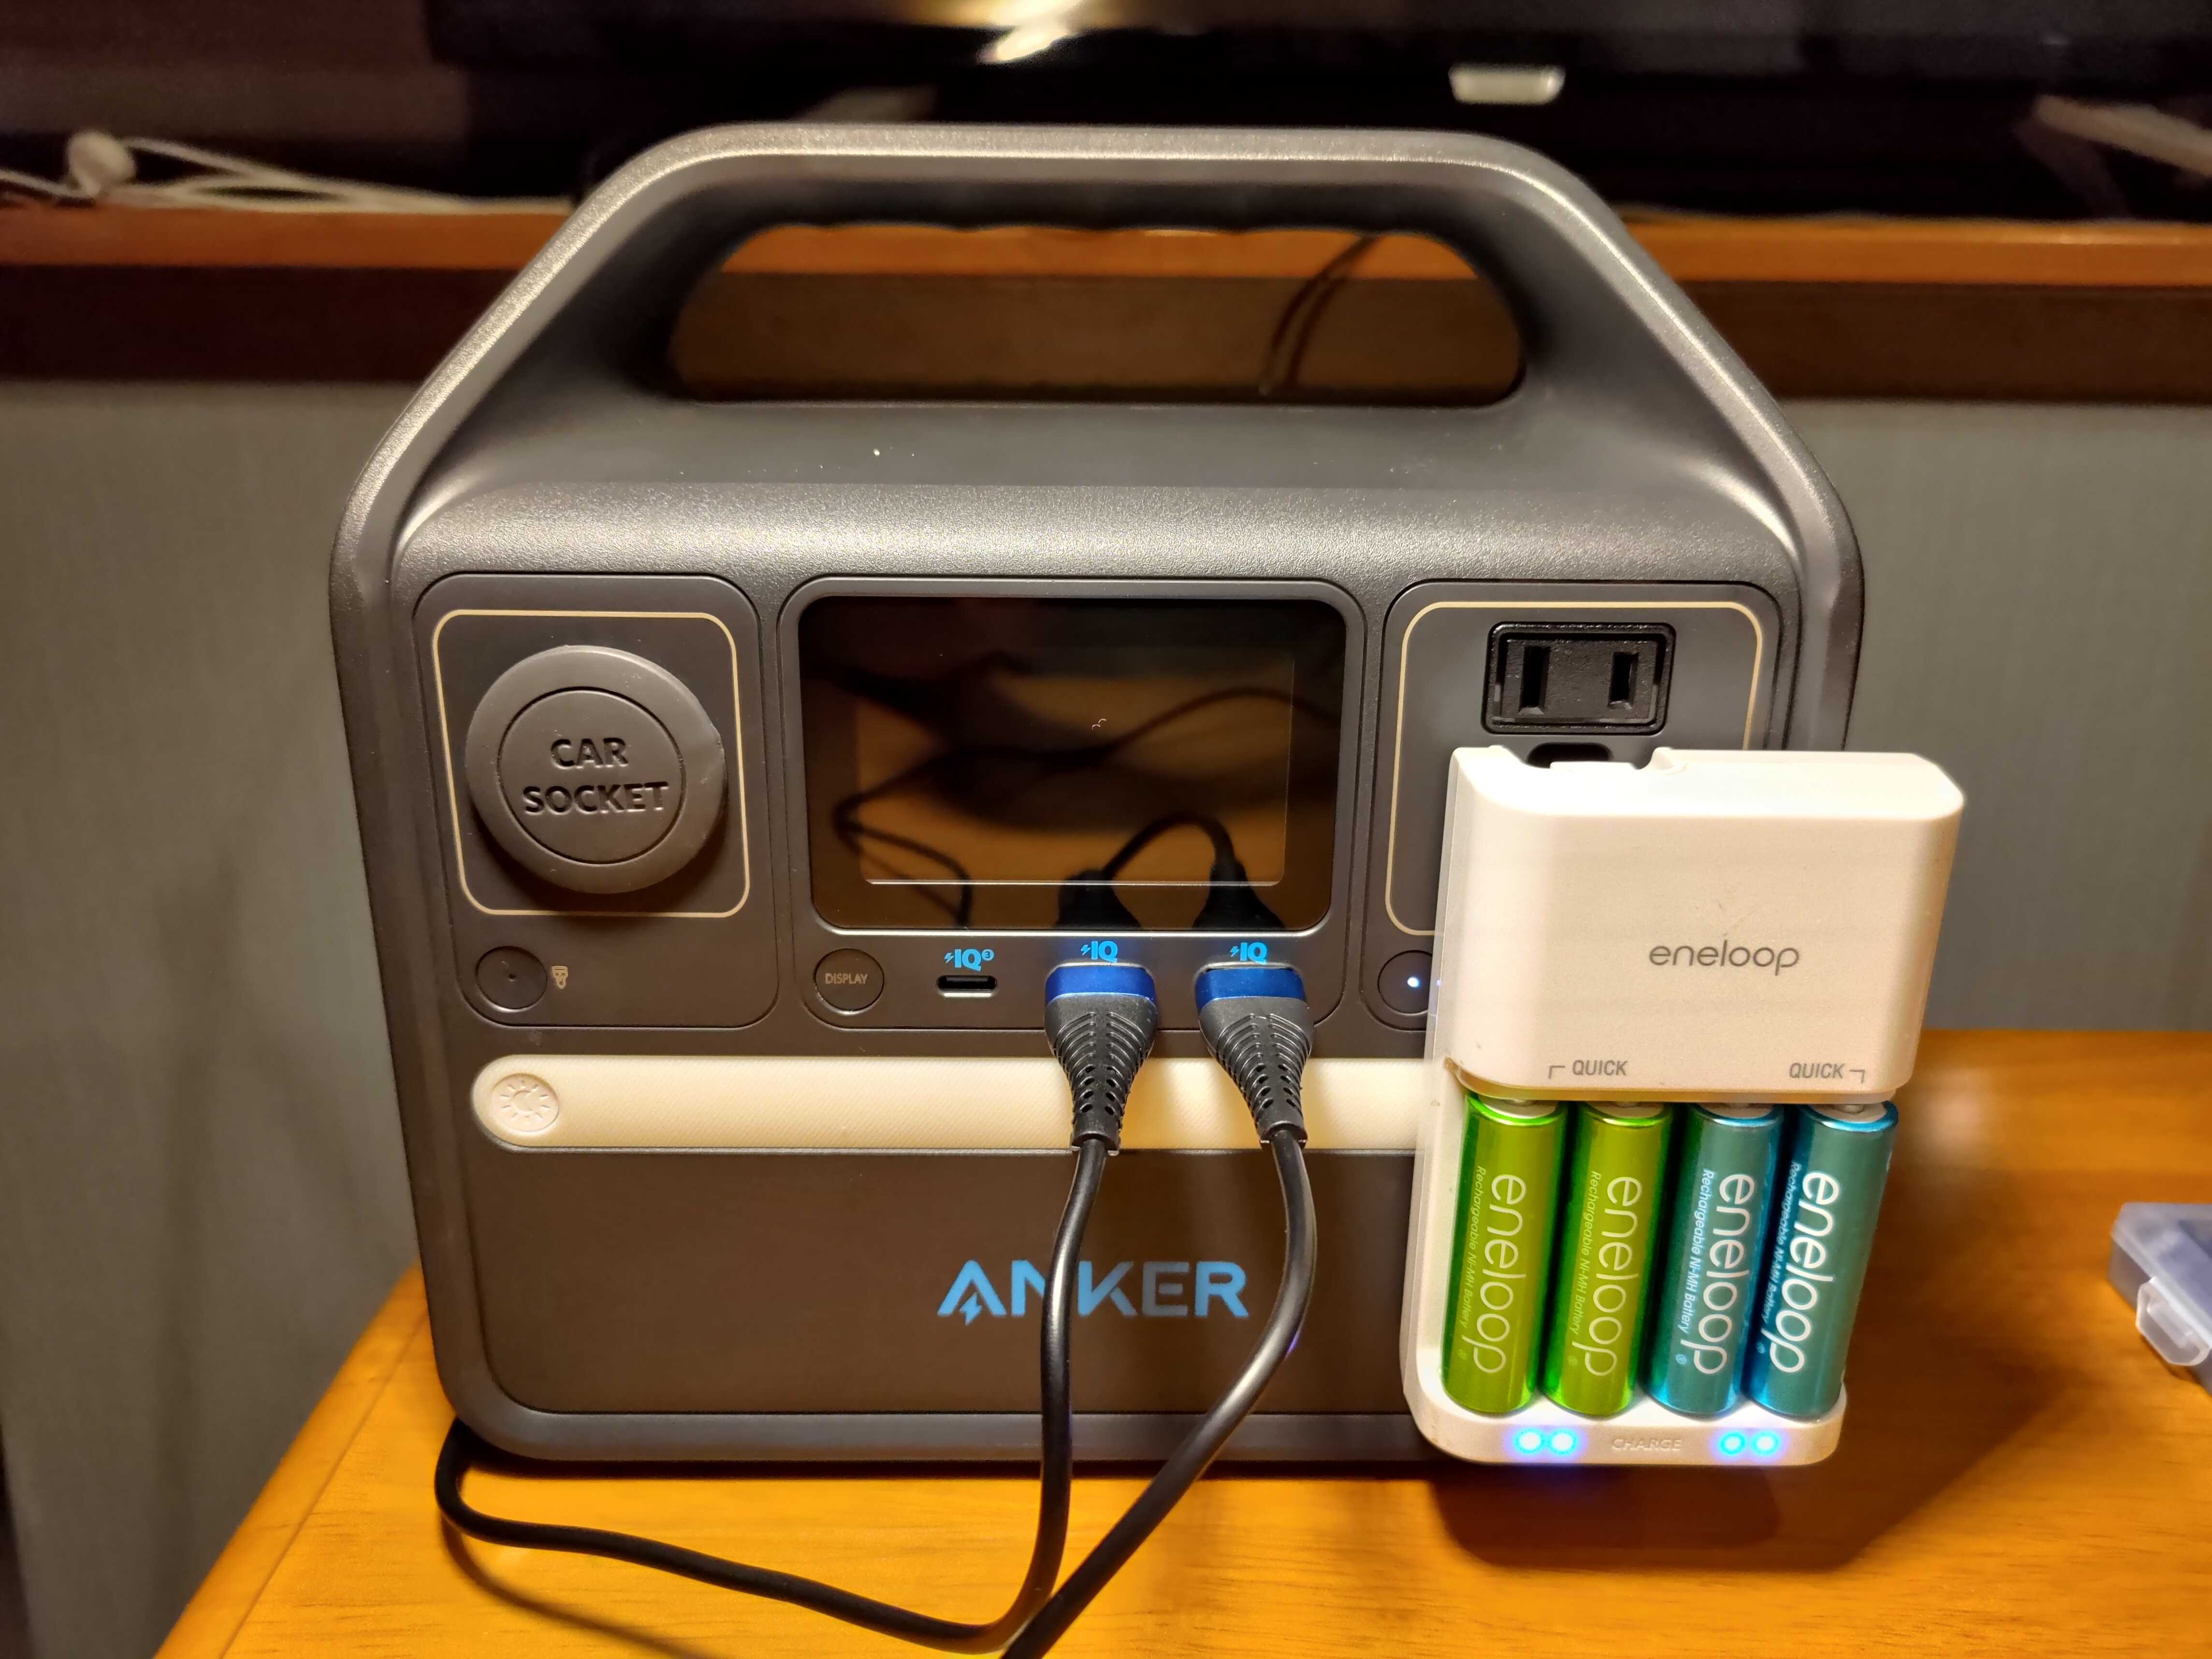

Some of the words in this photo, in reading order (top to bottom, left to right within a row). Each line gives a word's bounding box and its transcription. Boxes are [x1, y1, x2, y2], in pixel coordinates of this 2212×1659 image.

[551, 738, 628, 769] CAR
[523, 781, 669, 815] SOCKET
[1649, 940, 1800, 976] eneloop
[825, 973, 868, 985] DISPLAY
[1572, 1060, 1628, 1077] QUICK
[1789, 1062, 1845, 1079] QUICK
[1470, 1165, 1486, 1250] Rechargeable
[1582, 1170, 1601, 1255] Rechargeable
[1691, 1168, 1714, 1254] Rechargeable
[1777, 1162, 1802, 1245] Rechargeable
[937, 1259, 1249, 1324] ANKER
[1461, 1174, 1527, 1373] eneloop
[1572, 1176, 1643, 1376] eneloop
[1680, 1174, 1755, 1374] eneloop
[1761, 1172, 1839, 1373] eneloop
[1459, 1288, 1473, 1328] Battery
[1570, 1295, 1586, 1335] Battery
[1678, 1294, 1695, 1334] Battery
[1612, 1438, 1683, 1451] CHARGE
